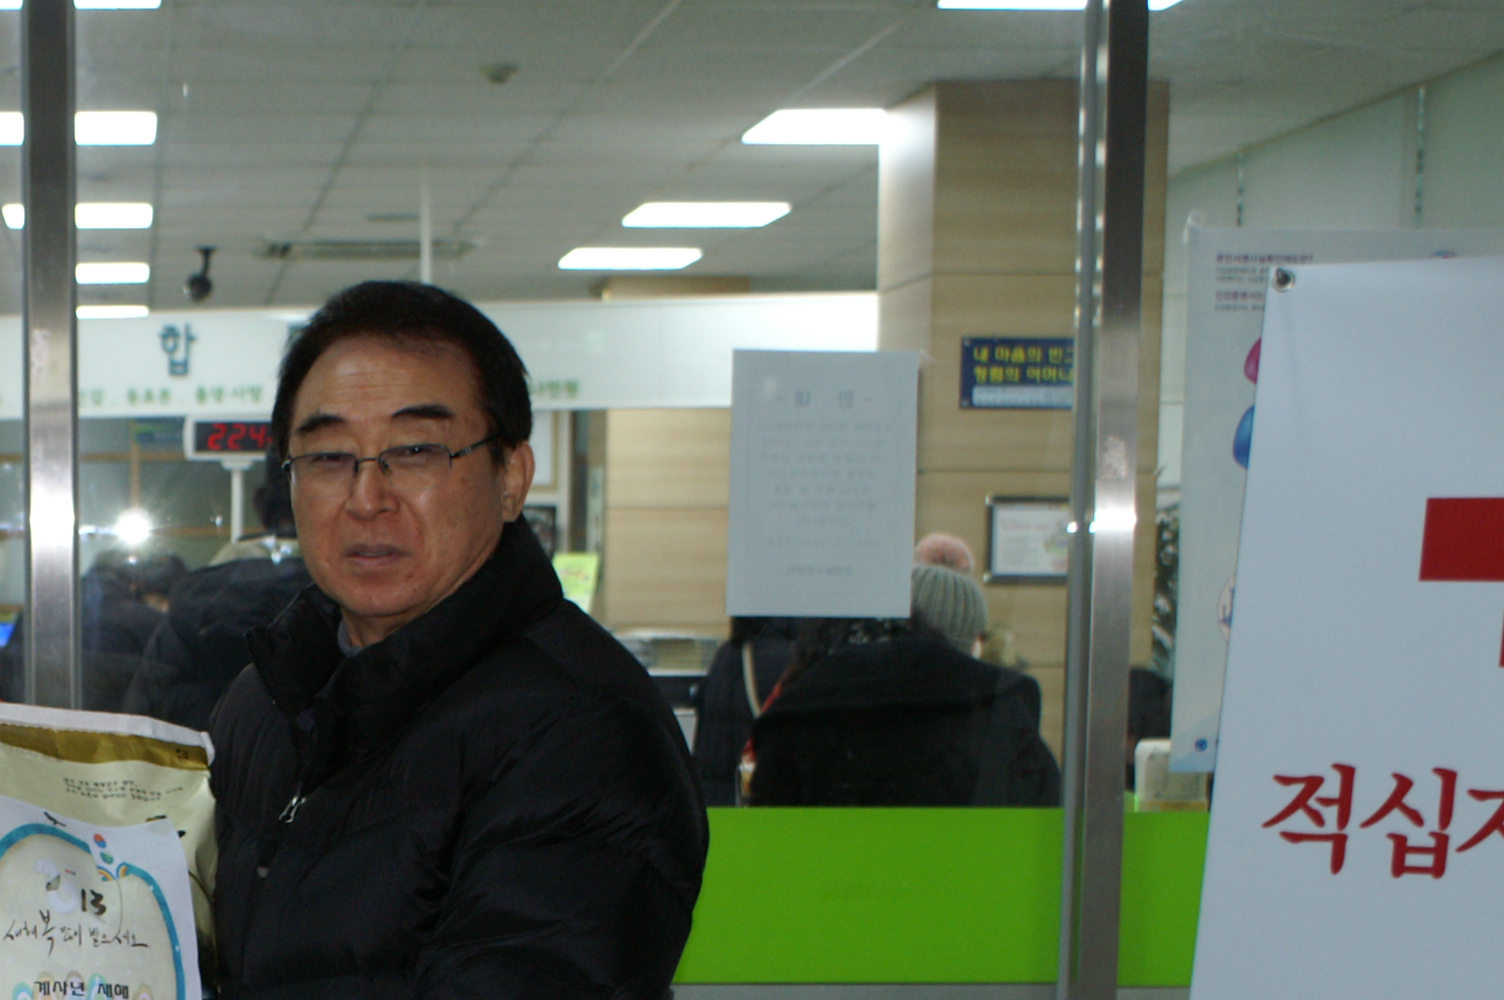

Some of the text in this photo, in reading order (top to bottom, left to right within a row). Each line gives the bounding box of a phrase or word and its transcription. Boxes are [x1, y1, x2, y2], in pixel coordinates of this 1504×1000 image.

[158, 323, 198, 377] 합
[207, 423, 273, 451] 224
[34, 980, 130, 999] 계사년 새해
